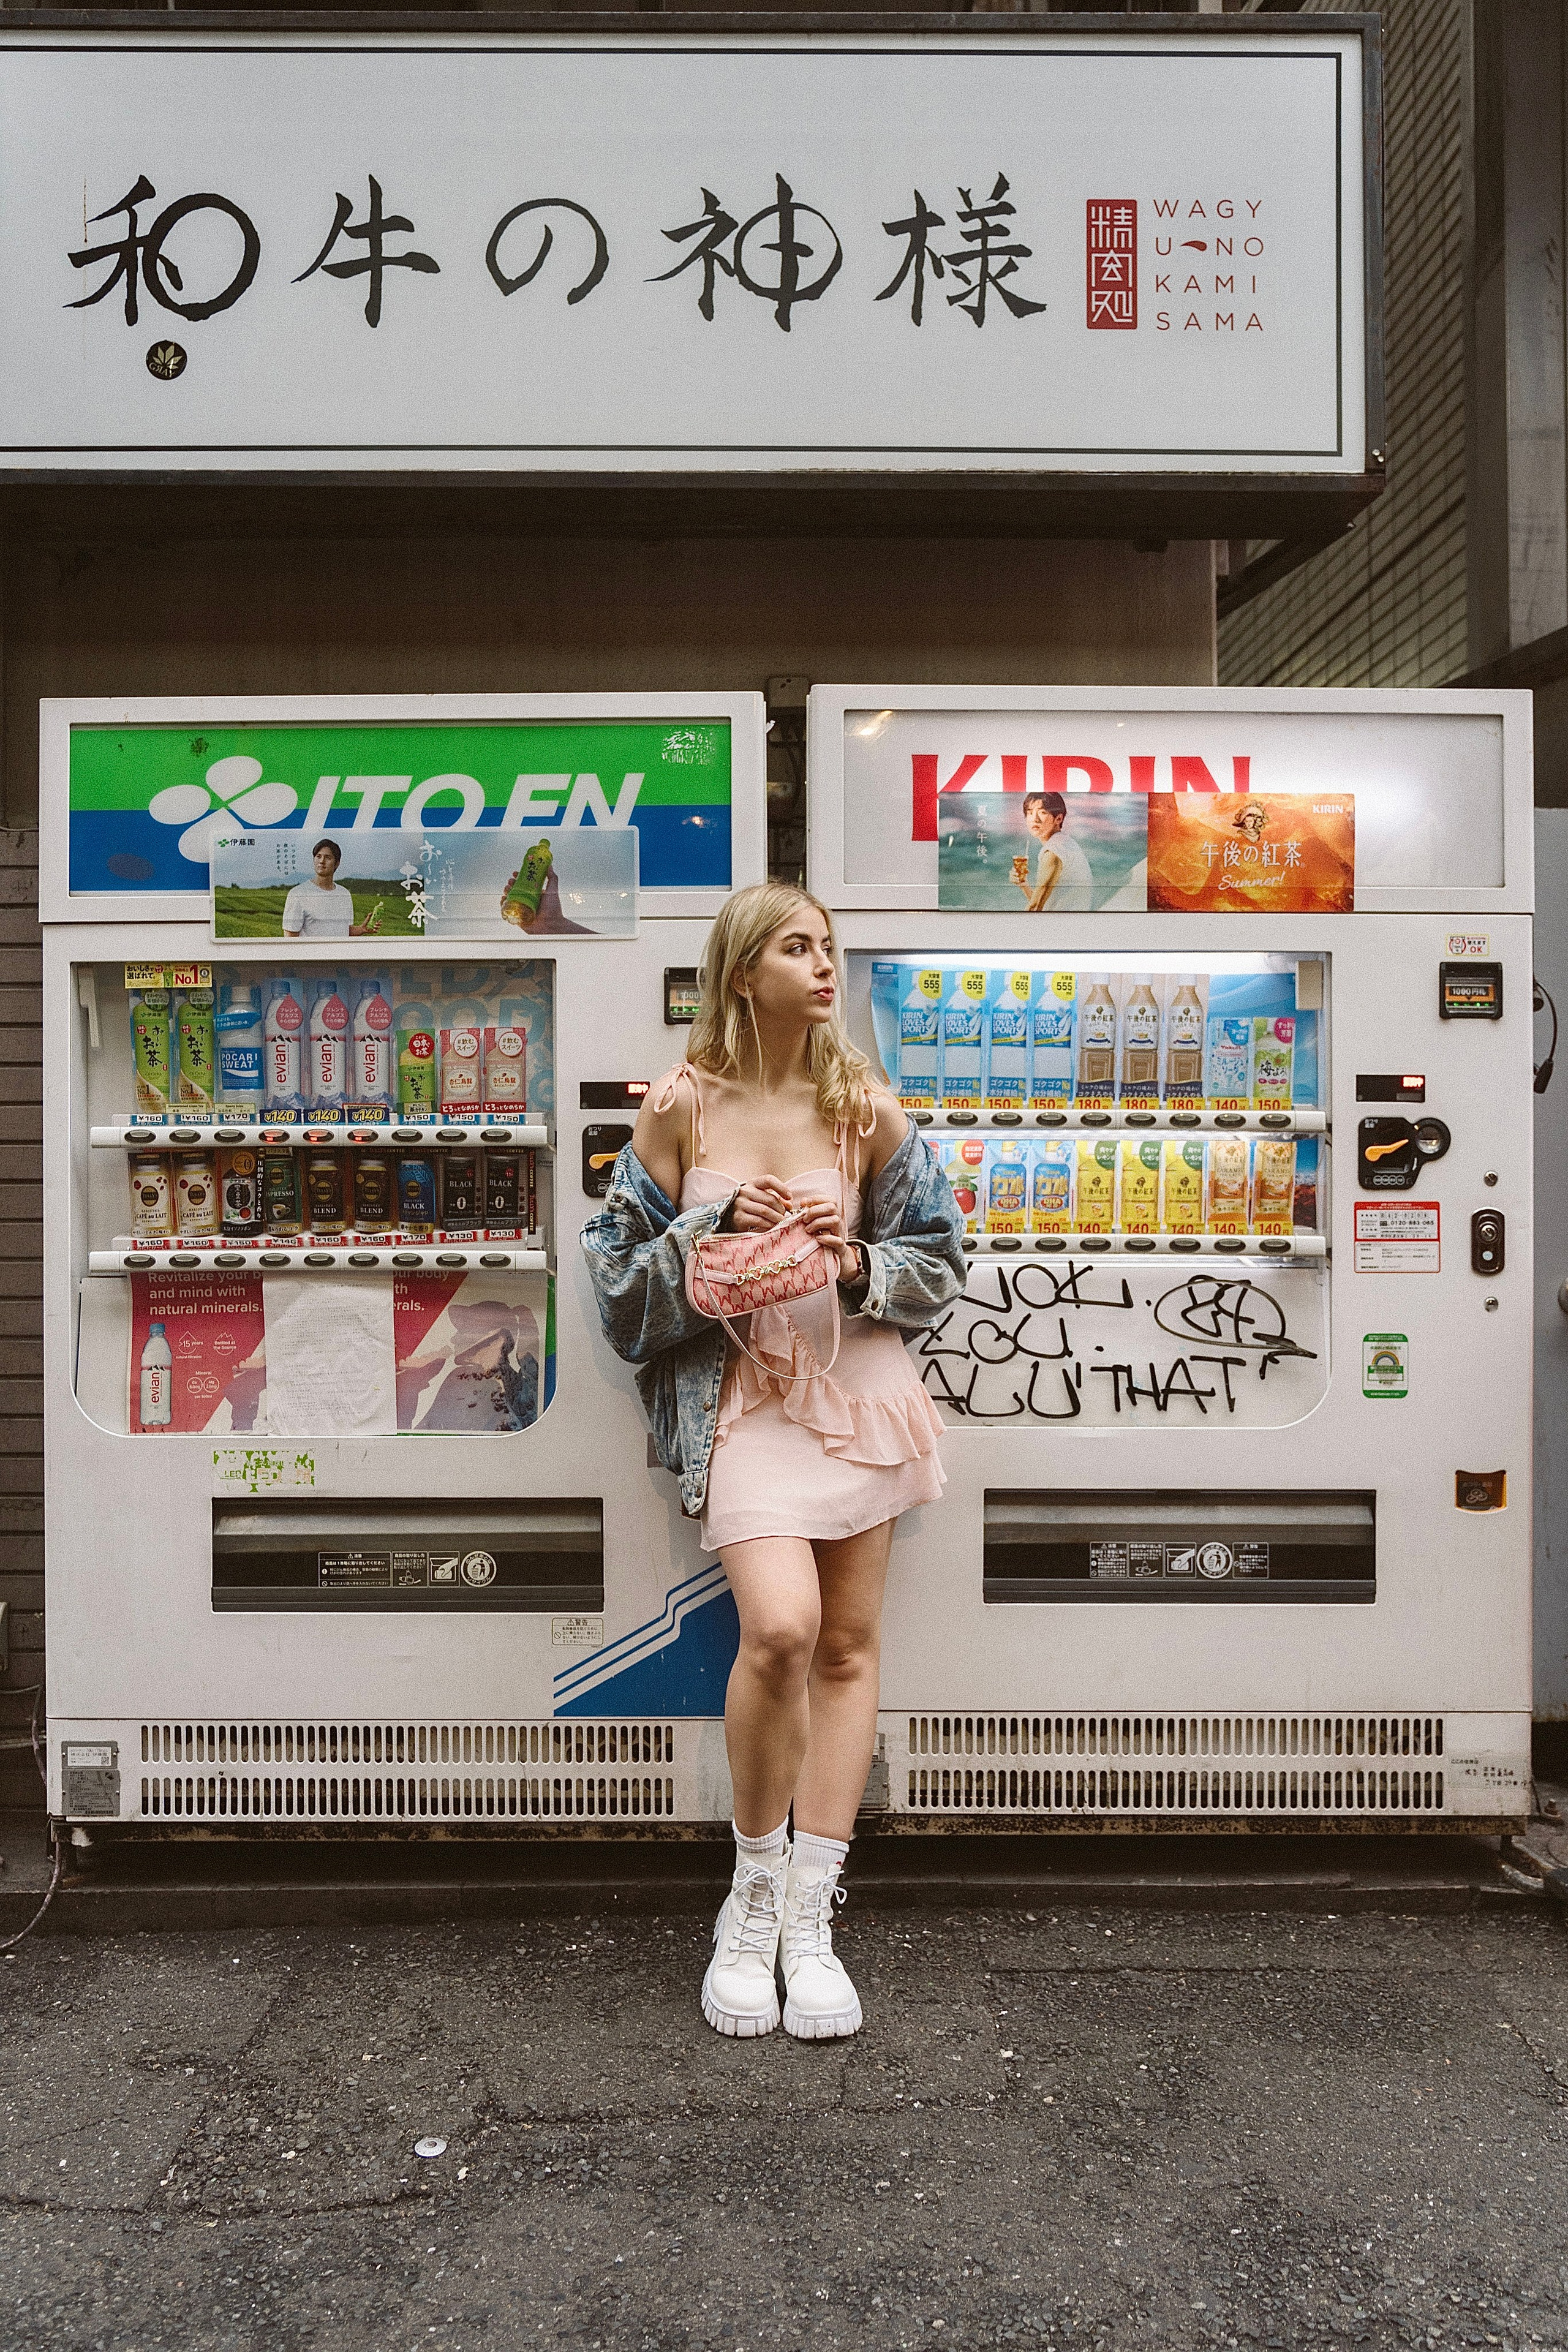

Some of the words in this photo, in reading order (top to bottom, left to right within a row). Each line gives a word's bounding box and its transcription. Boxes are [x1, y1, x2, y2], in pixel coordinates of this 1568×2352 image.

[1153, 200, 1262, 218] WAGY
[62, 172, 1047, 333] 和牛の神様
[1156, 275, 1256, 293] KAMI
[1156, 312, 1263, 331] SAMA
[1312, 804, 1344, 814] KIRIN
[1200, 840, 1302, 868] 午後の紅茶
[1218, 871, 1286, 891] Summer!
[175, 964, 198, 984] No.1
[924, 980, 940, 989] 555
[967, 981, 983, 990] 555
[1016, 981, 1028, 990] 555
[1057, 982, 1072, 991] 555
[274, 1044, 286, 1083] evian
[320, 1044, 332, 1083] evian
[363, 1044, 375, 1083] evian
[264, 1110, 297, 1123] ¥140
[308, 1109, 341, 1123] ¥140
[352, 1108, 385, 1122] ¥140
[456, 1196, 466, 1209] 0
[495, 1196, 505, 1208] 0
[148, 1272, 214, 1283] Revitalize
[219, 1272, 250, 1283] your
[149, 1287, 175, 1298] and
[179, 1286, 213, 1297] mind
[216, 1285, 246, 1297] with
[150, 1303, 197, 1315] natural
[202, 1301, 263, 1314] minerals.
[150, 1372, 160, 1403] evian
